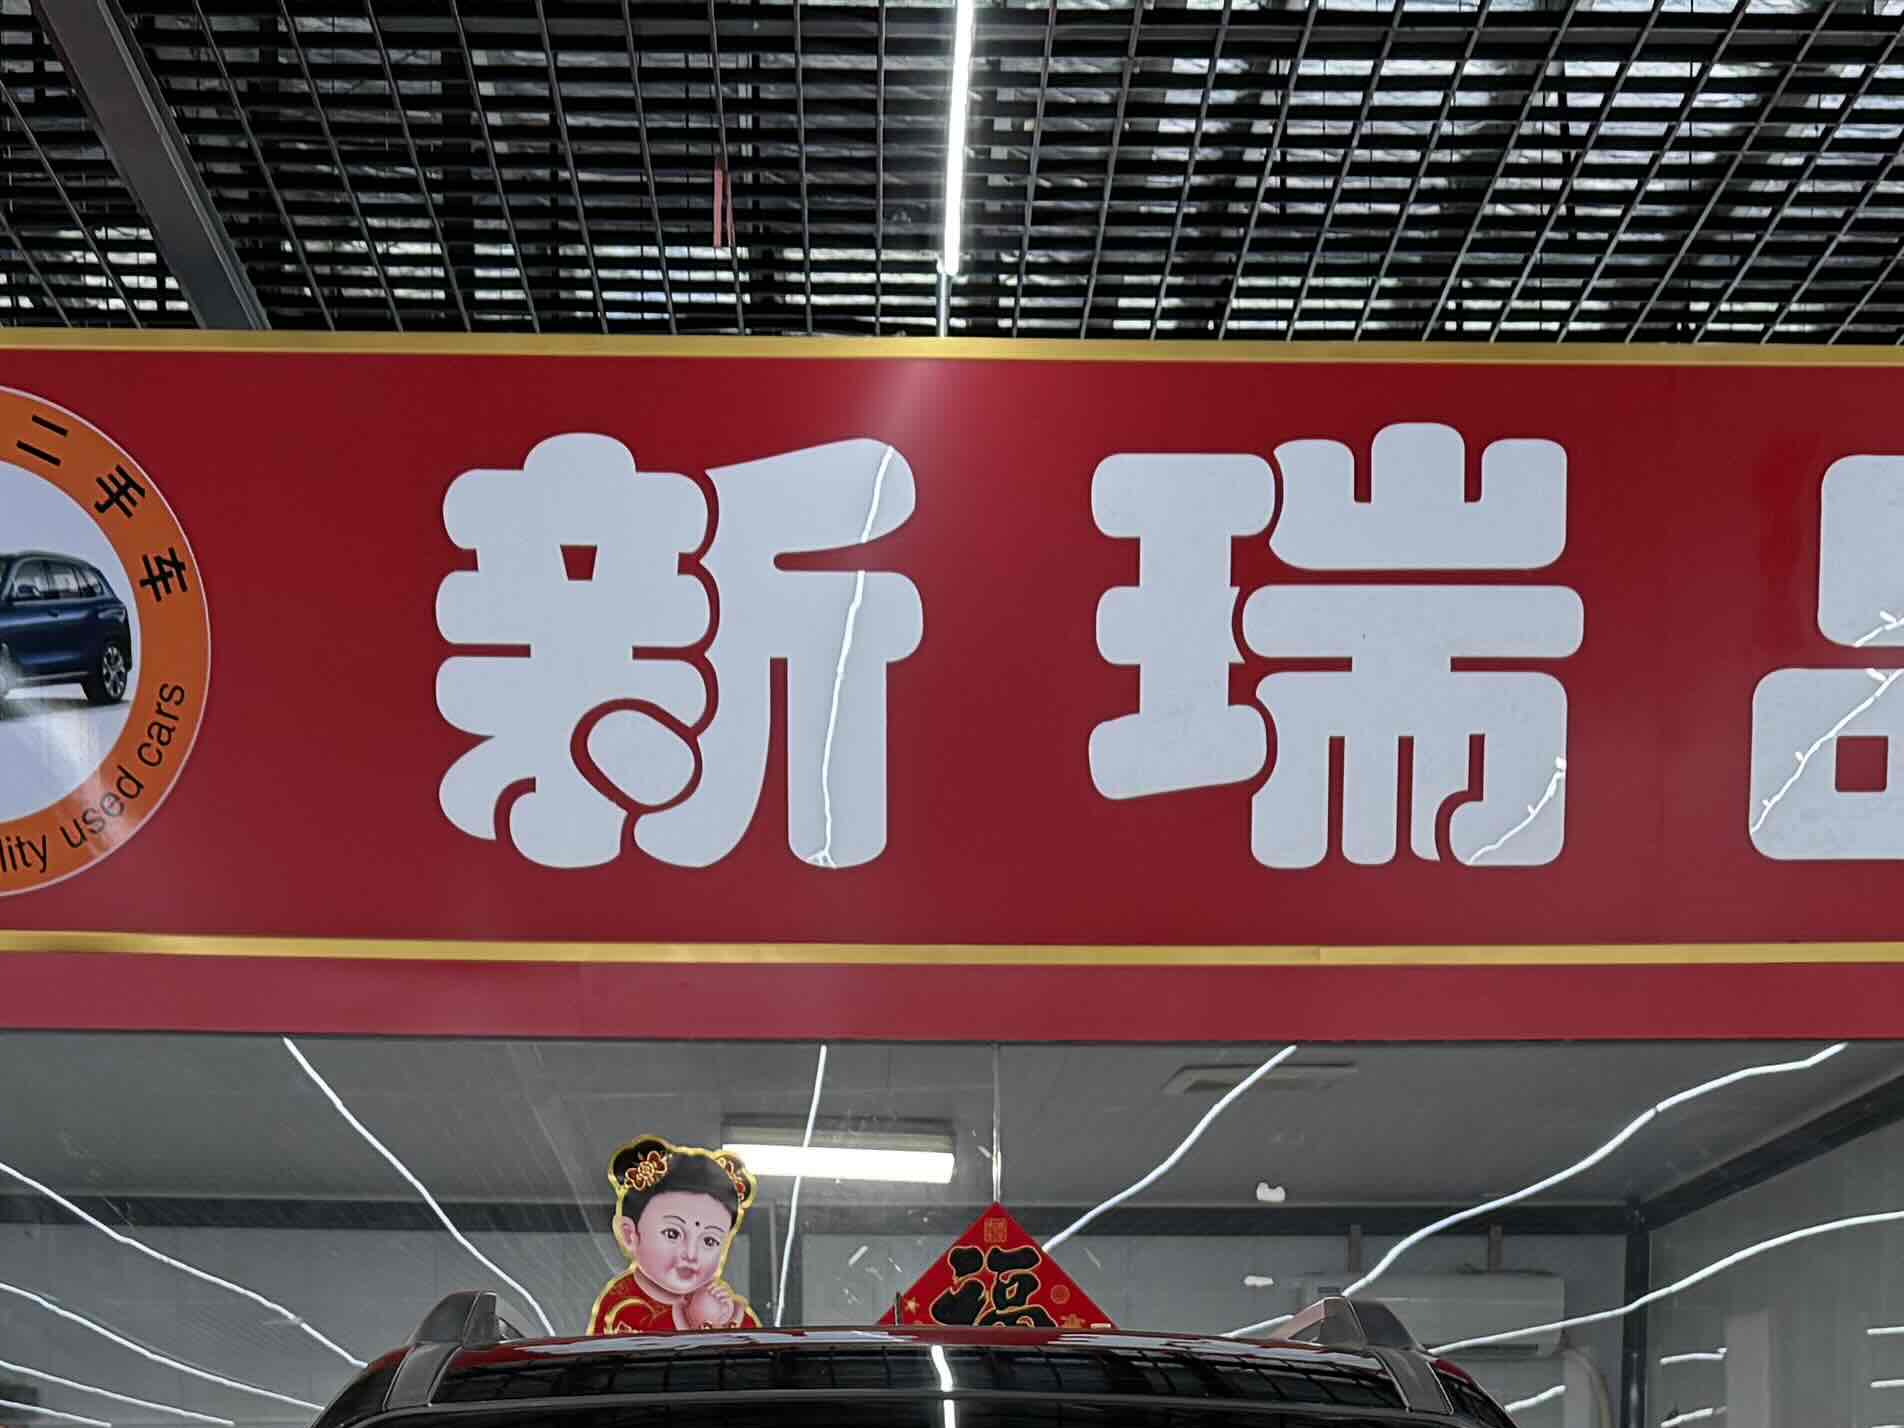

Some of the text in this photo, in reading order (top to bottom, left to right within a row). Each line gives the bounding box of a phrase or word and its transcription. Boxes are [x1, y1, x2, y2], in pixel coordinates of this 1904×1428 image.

[60, 767, 144, 850] used
[138, 683, 185, 769] cars
[929, 1246, 1059, 1328] 福
